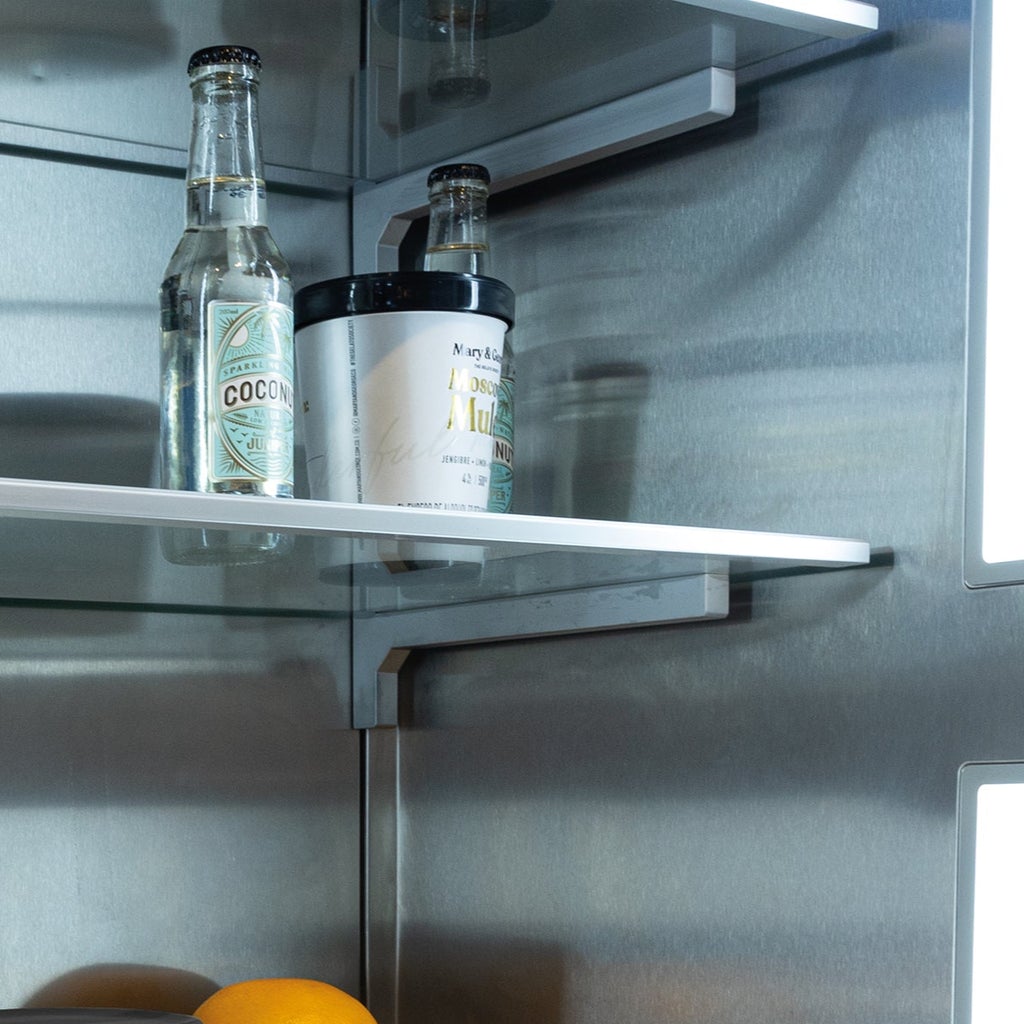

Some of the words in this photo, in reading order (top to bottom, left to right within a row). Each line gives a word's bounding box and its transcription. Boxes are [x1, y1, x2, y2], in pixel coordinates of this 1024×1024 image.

[453, 343, 483, 361] Mary
[484, 346, 492, 360] &
[224, 380, 293, 408] COCONU
[448, 367, 496, 398] Mosco
[447, 394, 495, 436] Mul
